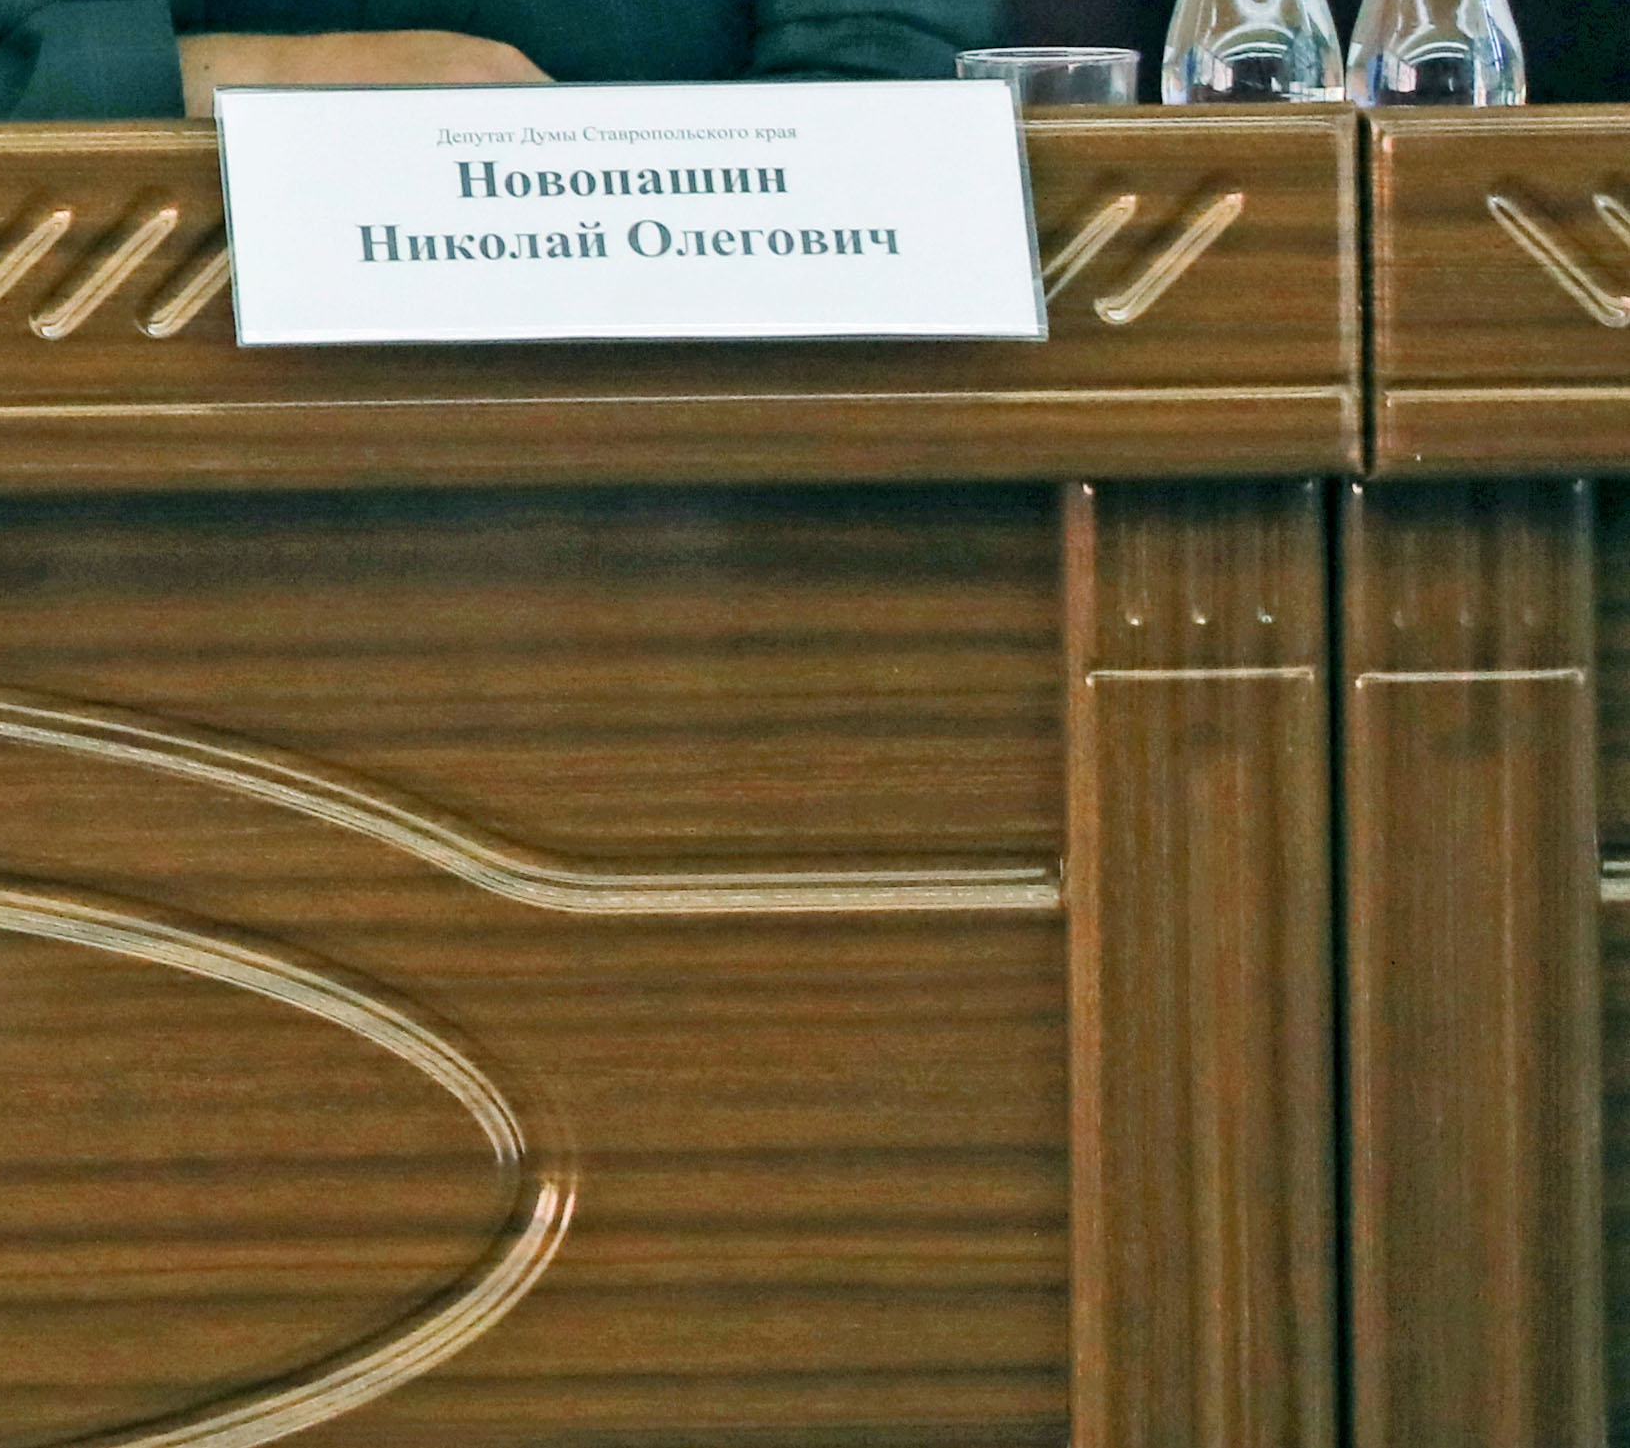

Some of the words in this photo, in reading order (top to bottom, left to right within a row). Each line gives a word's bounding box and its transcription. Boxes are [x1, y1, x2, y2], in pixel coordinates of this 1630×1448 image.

[436, 128, 517, 149] Депутат
[520, 127, 578, 148] Думы
[582, 125, 751, 147] Ставропольского
[755, 126, 799, 146] края
[454, 160, 789, 200] Новопашин
[358, 217, 610, 264] Николай
[627, 215, 901, 259] Олегович
